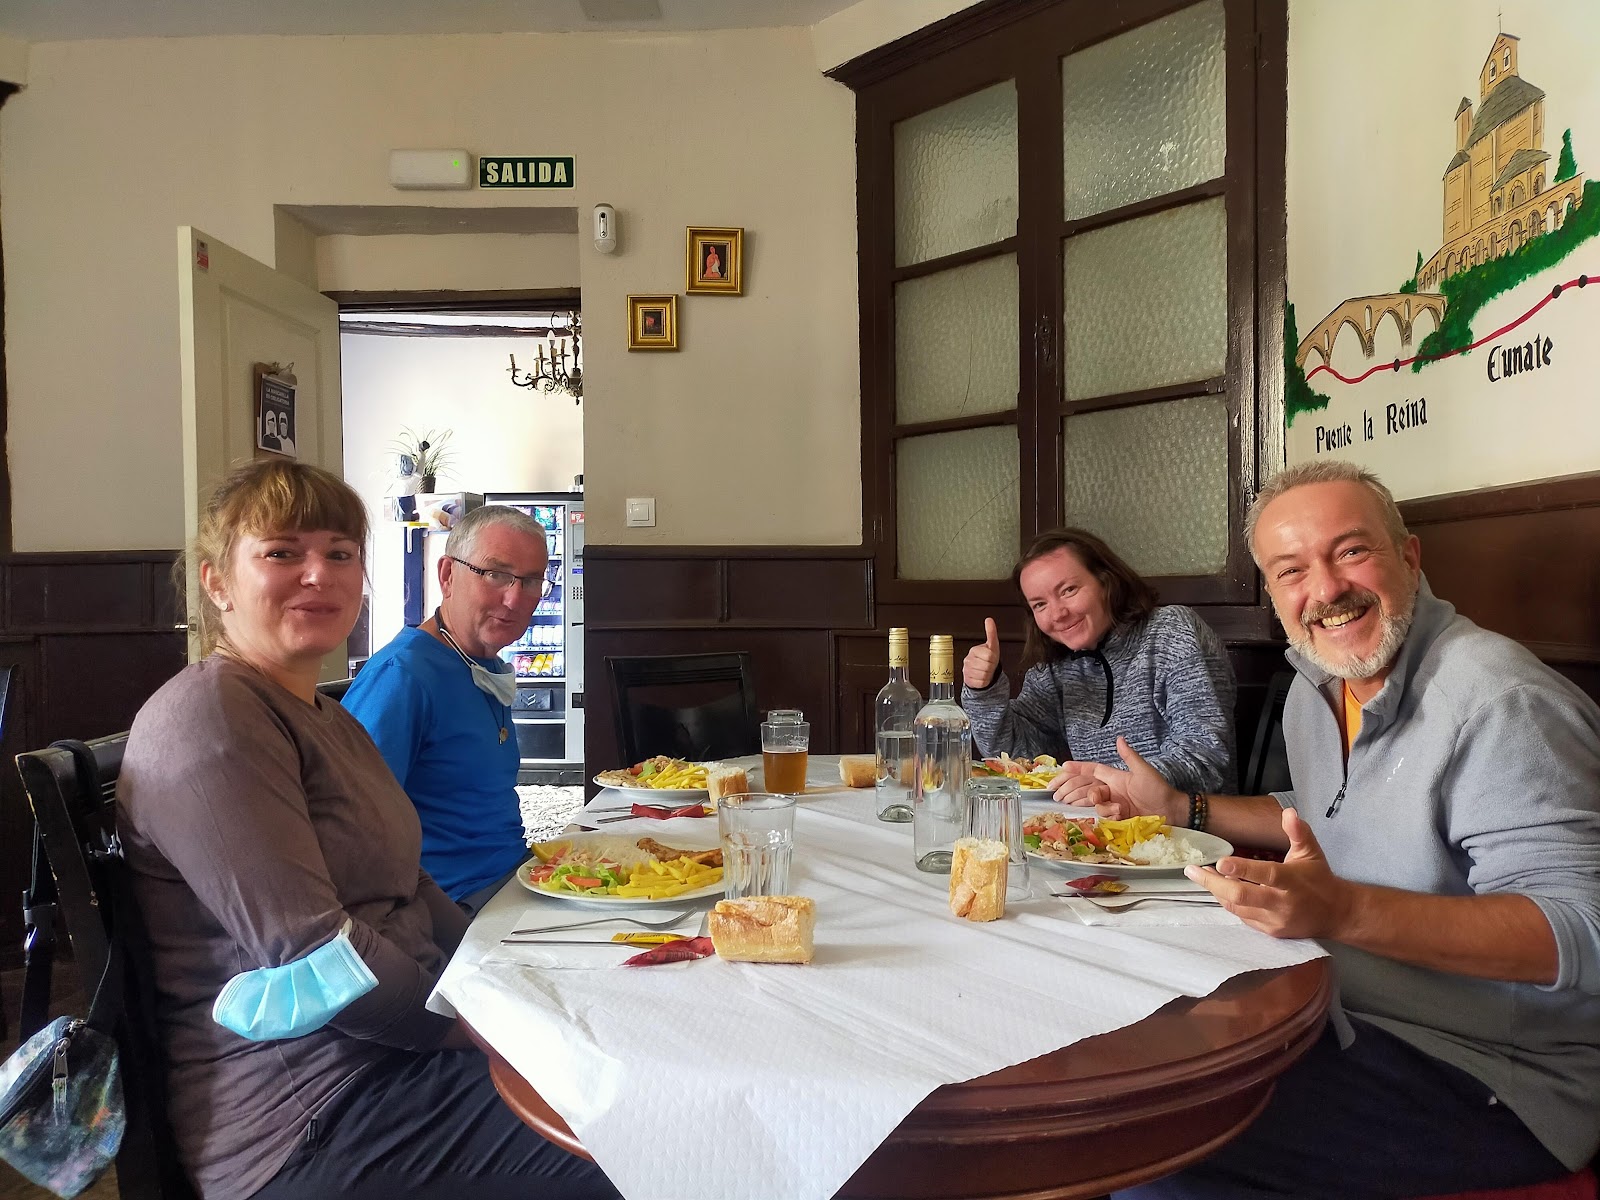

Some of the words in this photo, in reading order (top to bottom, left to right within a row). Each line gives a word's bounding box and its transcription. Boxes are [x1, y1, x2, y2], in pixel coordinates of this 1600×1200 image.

[486, 162, 567, 183] SALIDA
[1487, 333, 1554, 383] Eunate
[1315, 421, 1352, 453] Puente
[1363, 409, 1374, 441] la
[1386, 397, 1428, 435] Reina
